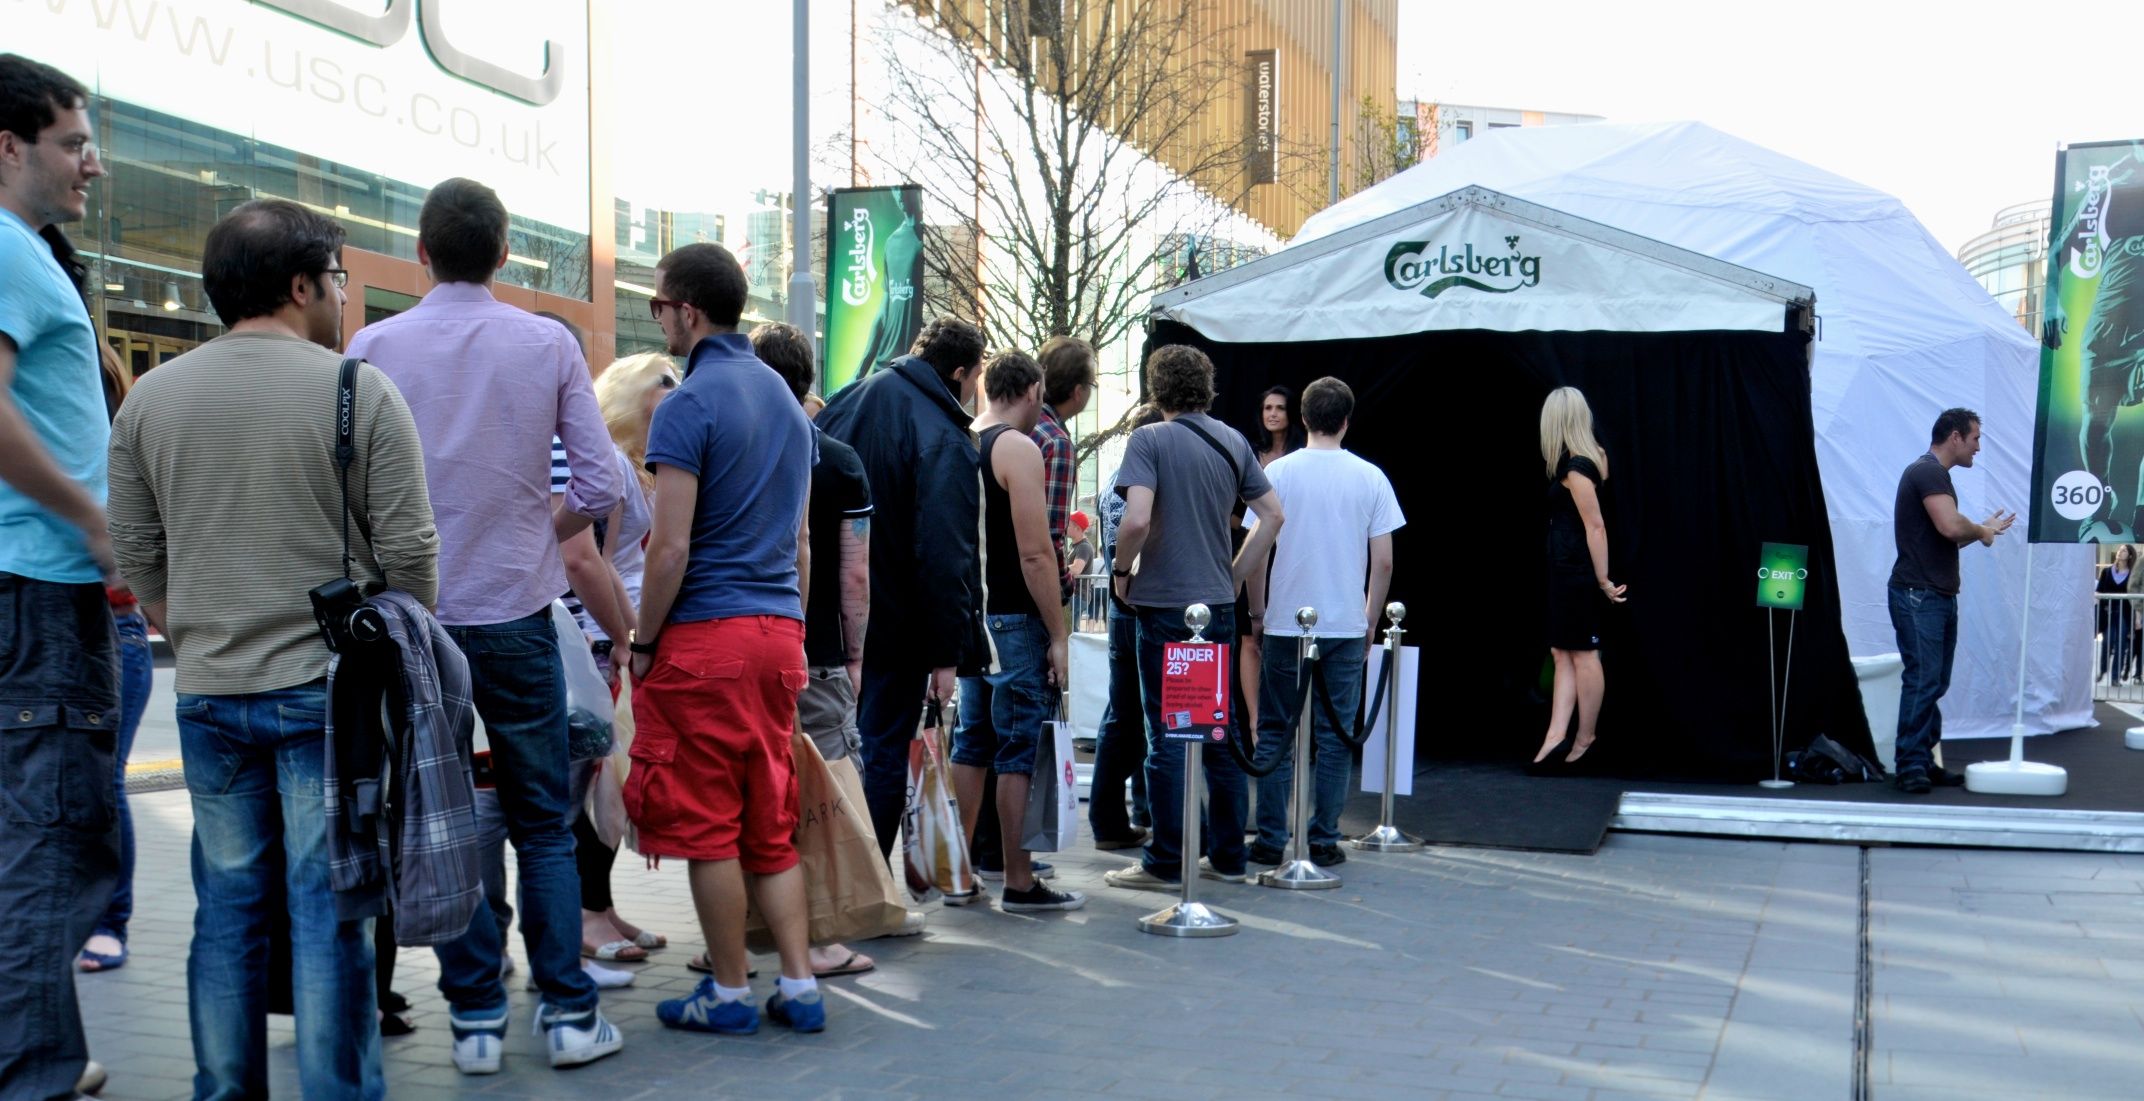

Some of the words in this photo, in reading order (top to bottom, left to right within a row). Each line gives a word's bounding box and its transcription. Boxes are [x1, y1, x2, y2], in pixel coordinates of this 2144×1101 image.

[12, 0, 560, 176] ww.usc.co.uk
[2070, 165, 2112, 279] Carlsberg
[842, 207, 877, 306] Carlsberg
[1384, 236, 1542, 299] Carlsberg
[341, 387, 351, 436] COOLPIX
[1771, 570, 1795, 580] EXIT
[1166, 662, 1190, 675] 25?
[1167, 648, 1214, 662] UNDER
